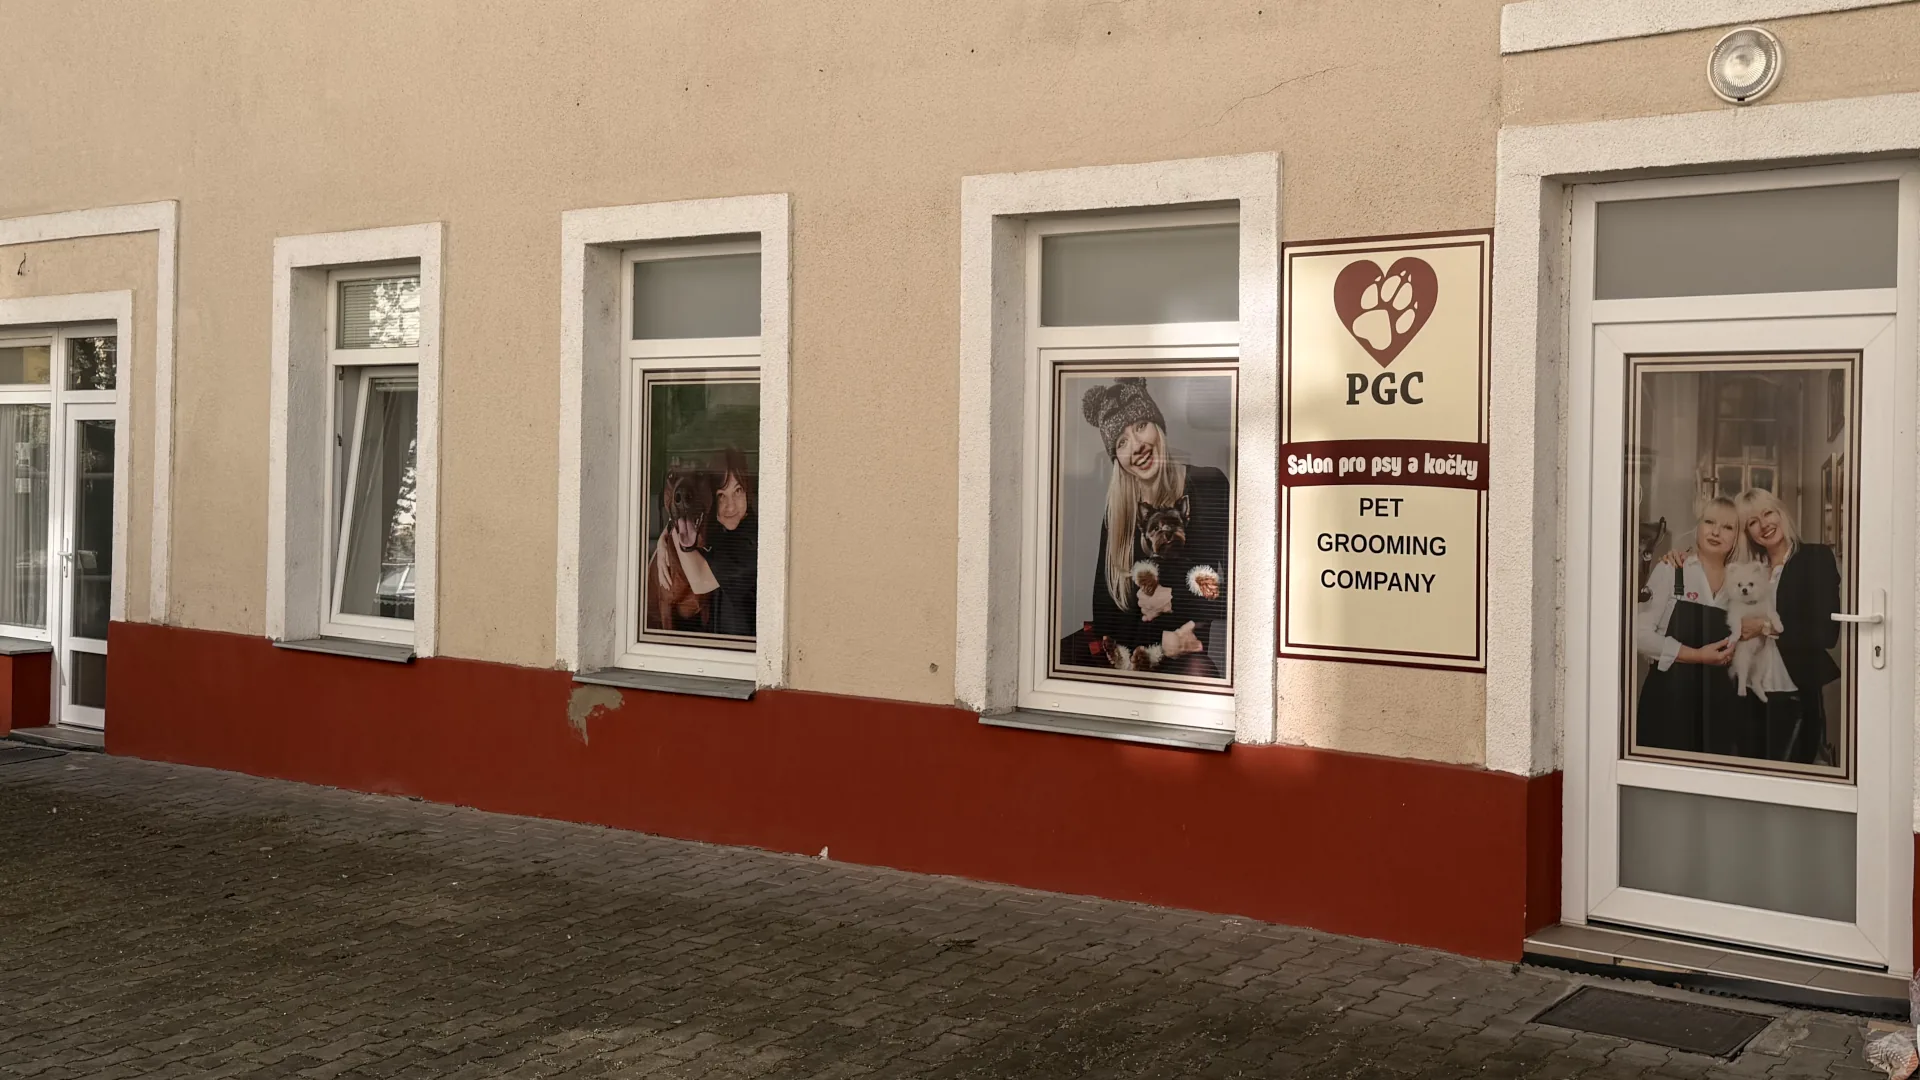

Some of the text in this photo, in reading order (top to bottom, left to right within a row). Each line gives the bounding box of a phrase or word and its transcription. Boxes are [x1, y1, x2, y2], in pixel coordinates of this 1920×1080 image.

[1346, 372, 1424, 405] PGC
[1287, 453, 1479, 481] Salon pro psy a kočky
[1359, 497, 1404, 517] PET
[1317, 532, 1447, 556] GROOMING
[1320, 569, 1436, 593] COMPANY
